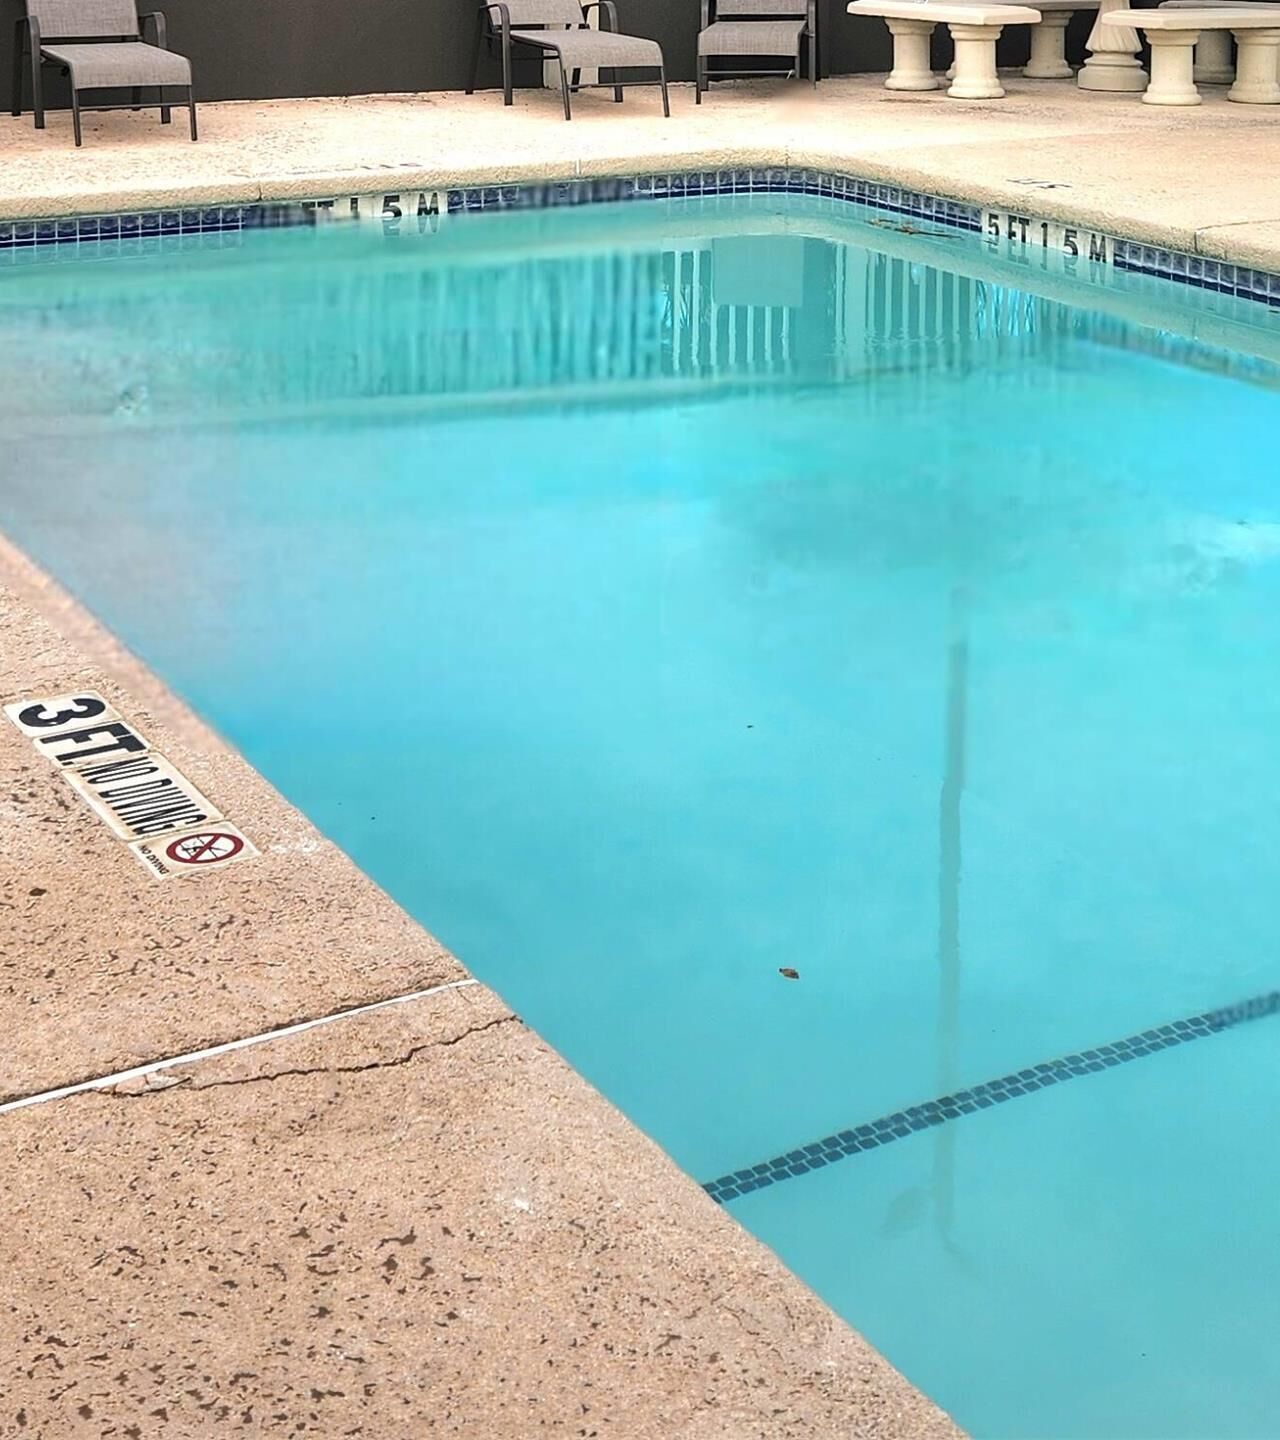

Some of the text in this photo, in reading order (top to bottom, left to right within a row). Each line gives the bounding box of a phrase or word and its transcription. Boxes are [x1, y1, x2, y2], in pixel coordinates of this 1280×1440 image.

[382, 195, 402, 217] 5
[417, 192, 439, 215] M
[987, 213, 1107, 263] 5 FT 1 5 M
[19, 698, 106, 727] 3
[76, 756, 160, 784] NO
[97, 778, 208, 835] DIVING
